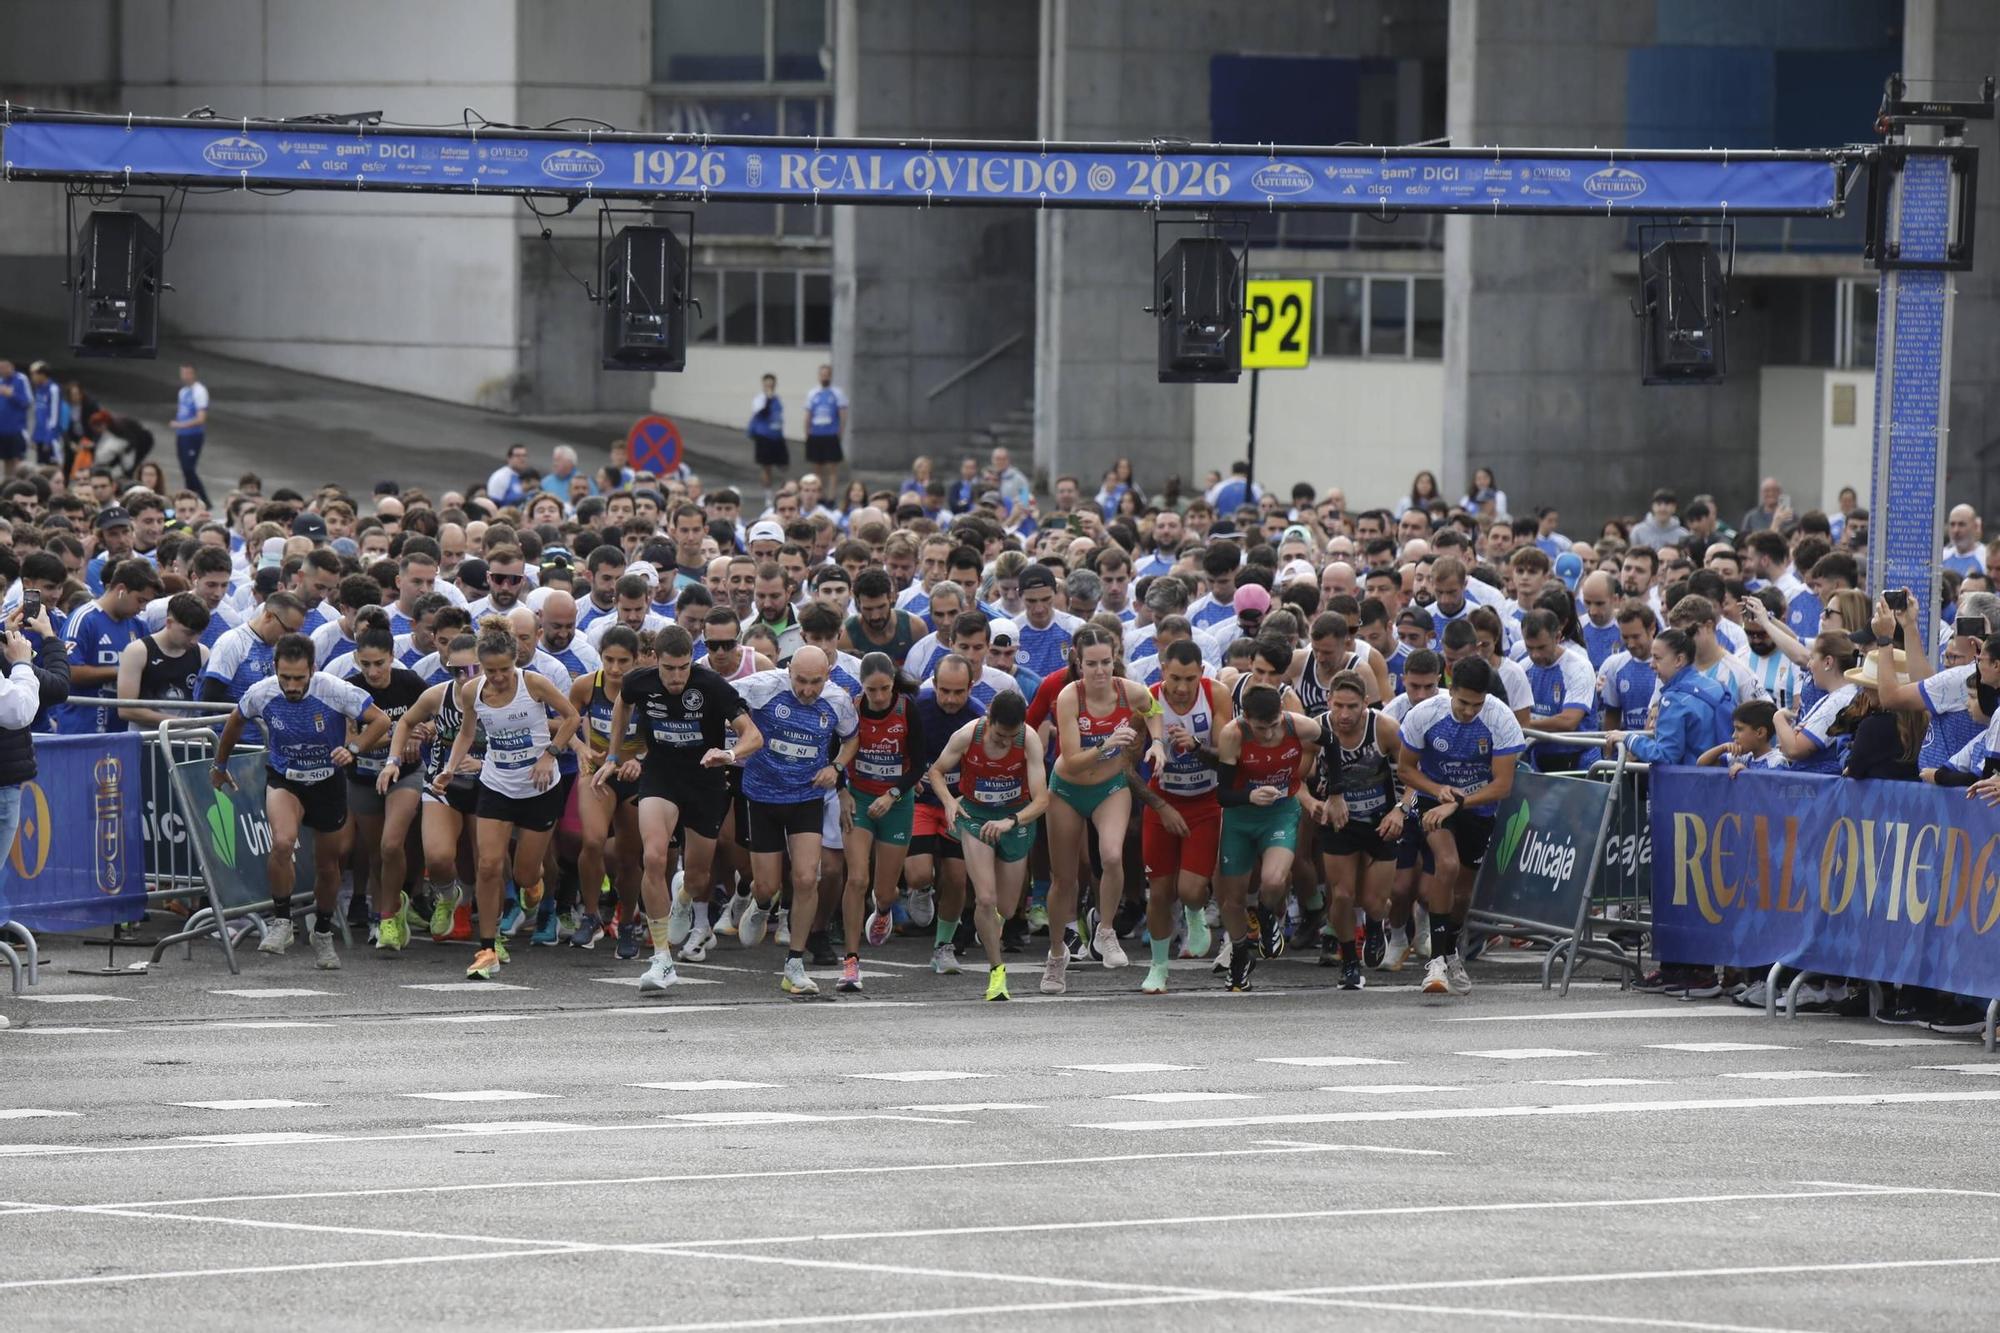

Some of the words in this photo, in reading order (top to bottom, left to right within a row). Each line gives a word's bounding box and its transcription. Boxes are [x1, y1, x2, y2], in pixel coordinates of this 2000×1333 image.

[207, 149, 264, 162] ASTURIANA
[379, 144, 414, 158] DIGI
[490, 147, 529, 157] OVIEDO
[322, 160, 348, 171] alsa
[545, 158, 602, 172] ASTURIANA
[632, 151, 726, 187] 1926
[780, 154, 893, 190] REAL
[903, 156, 1078, 195] OVIEDO
[1125, 160, 1231, 196] 2026
[1423, 167, 1459, 180] DIGI
[1533, 168, 1572, 177] OVIEDO
[1256, 174, 1310, 188] ASTURIANA
[1588, 179, 1643, 192] ASTURIANA
[1367, 184, 1393, 195] alsa
[1249, 294, 1303, 352] P2
[661, 721, 692, 730] MARCHA
[783, 729, 813, 741] MARCHA
[796, 747, 807, 756] 81
[310, 769, 330, 780] 560
[879, 766, 896, 775] 415
[1190, 773, 1204, 782] 60
[1519, 829, 1576, 892] Unicaja
[1672, 811, 1806, 924] REAL
[1819, 816, 2000, 935] OVIEDO
